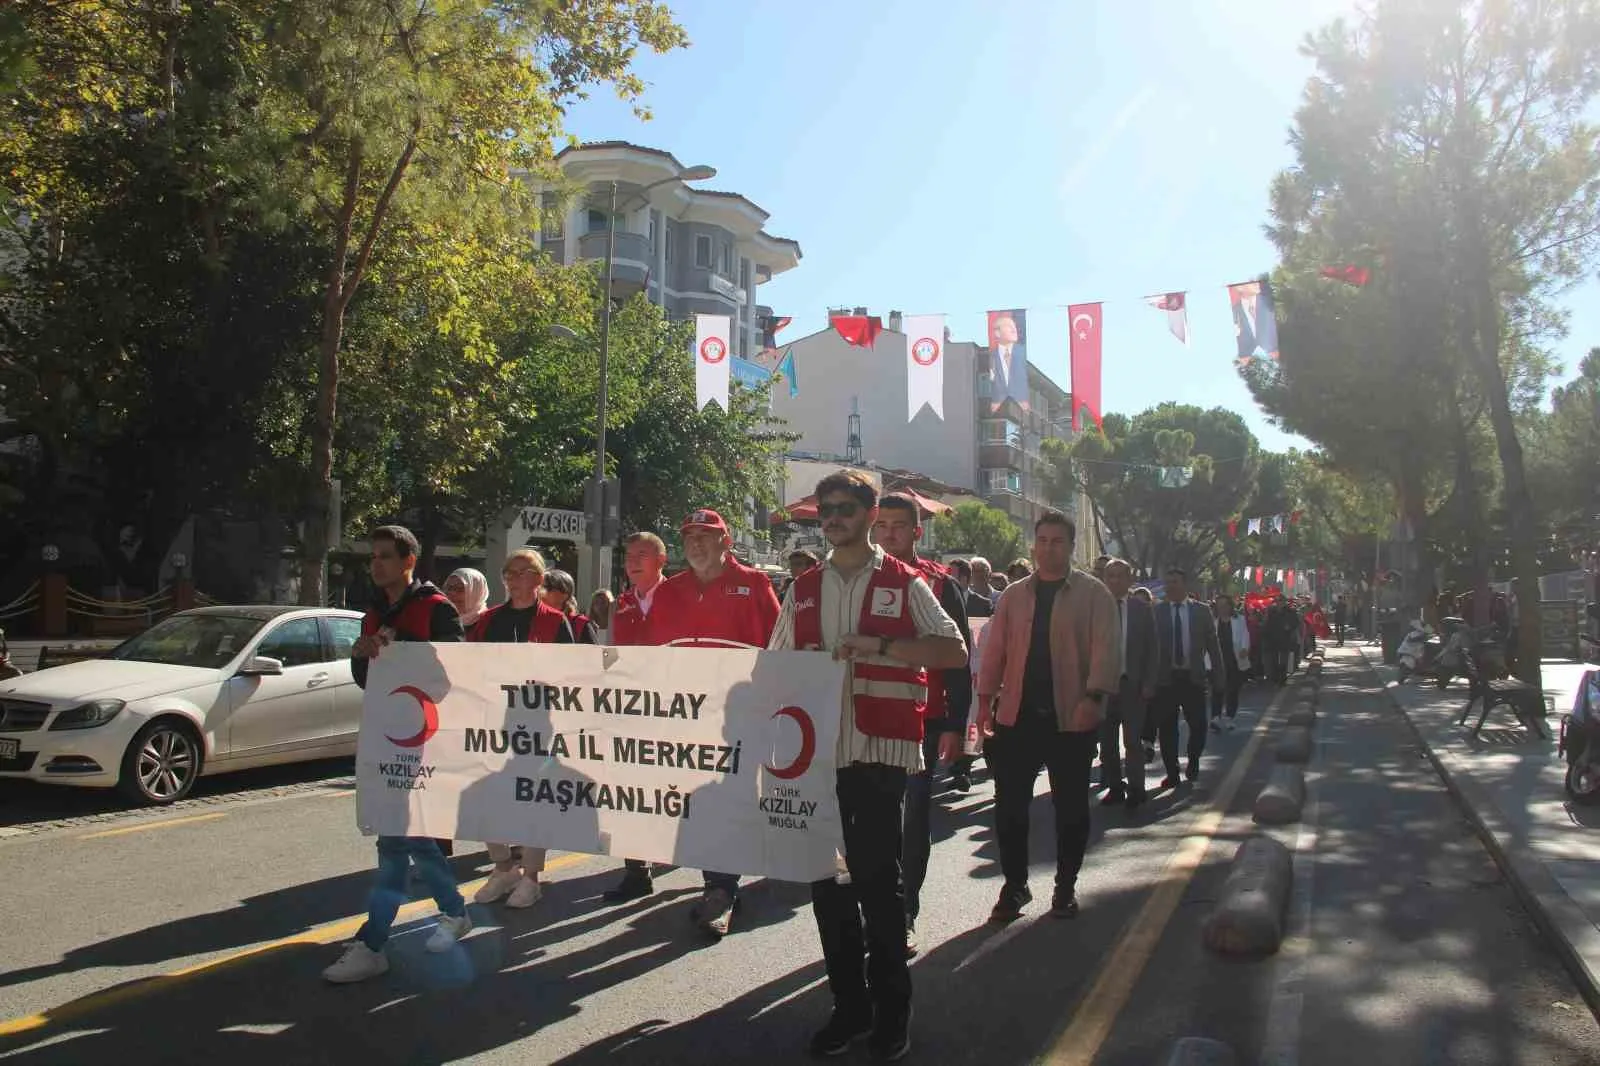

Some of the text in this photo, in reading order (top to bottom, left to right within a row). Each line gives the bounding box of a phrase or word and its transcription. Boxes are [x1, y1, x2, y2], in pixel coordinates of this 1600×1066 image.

[500, 679, 707, 720] TÜRK KIZILAY
[464, 724, 741, 775] MUĞLA İL MERKEZİ
[379, 762, 436, 778] KIZILAY
[387, 778, 426, 790] MUĞLA
[515, 776, 691, 819] BAŞKANLIĞI
[759, 797, 817, 817] KIZILAY
[768, 815, 808, 831] MUĞLA
